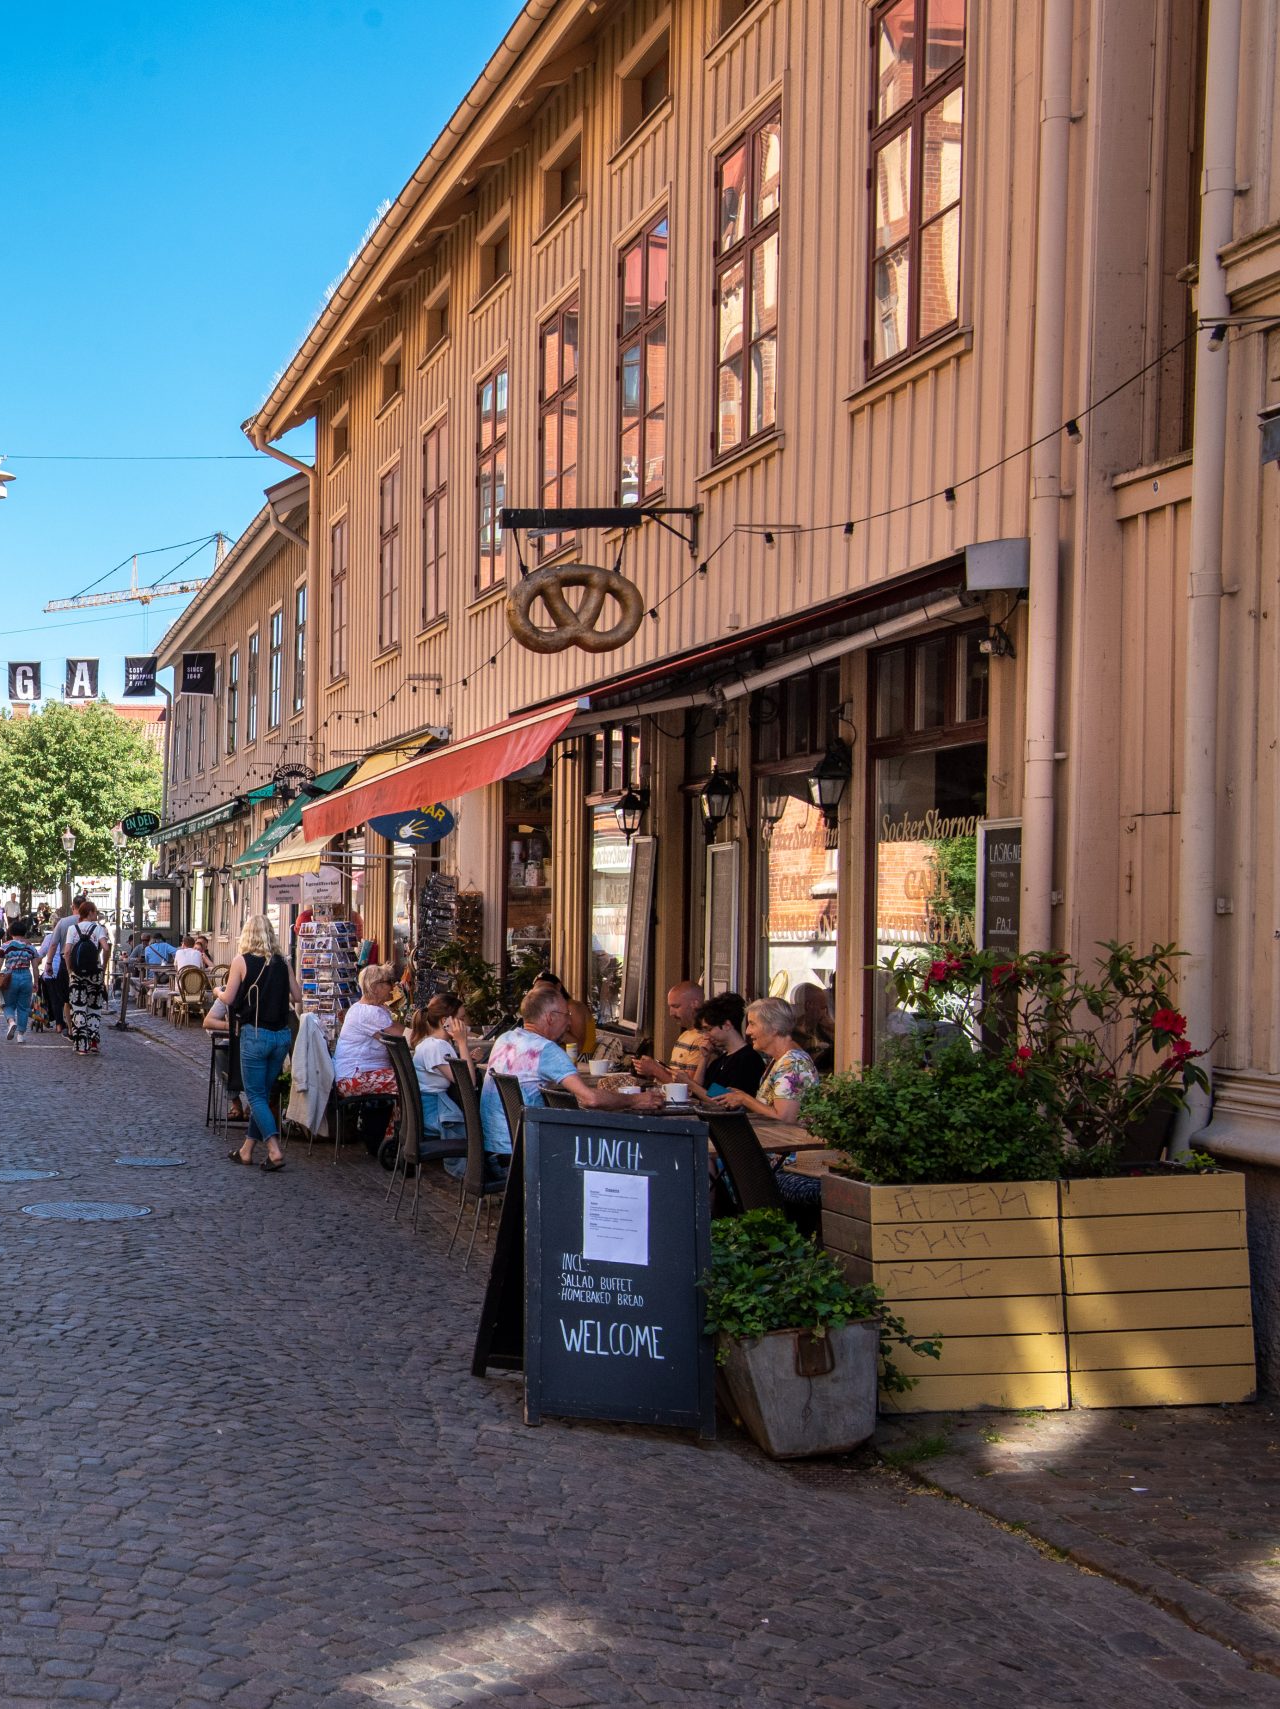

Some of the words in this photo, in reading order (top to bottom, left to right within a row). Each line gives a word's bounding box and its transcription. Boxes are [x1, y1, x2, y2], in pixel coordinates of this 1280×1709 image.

[125, 819, 136, 830] EN
[574, 1136, 639, 1171] LUNCH
[600, 1276, 633, 1292] BUFFET
[617, 1293, 644, 1307] BREAD
[560, 1319, 665, 1360] WELCOME
